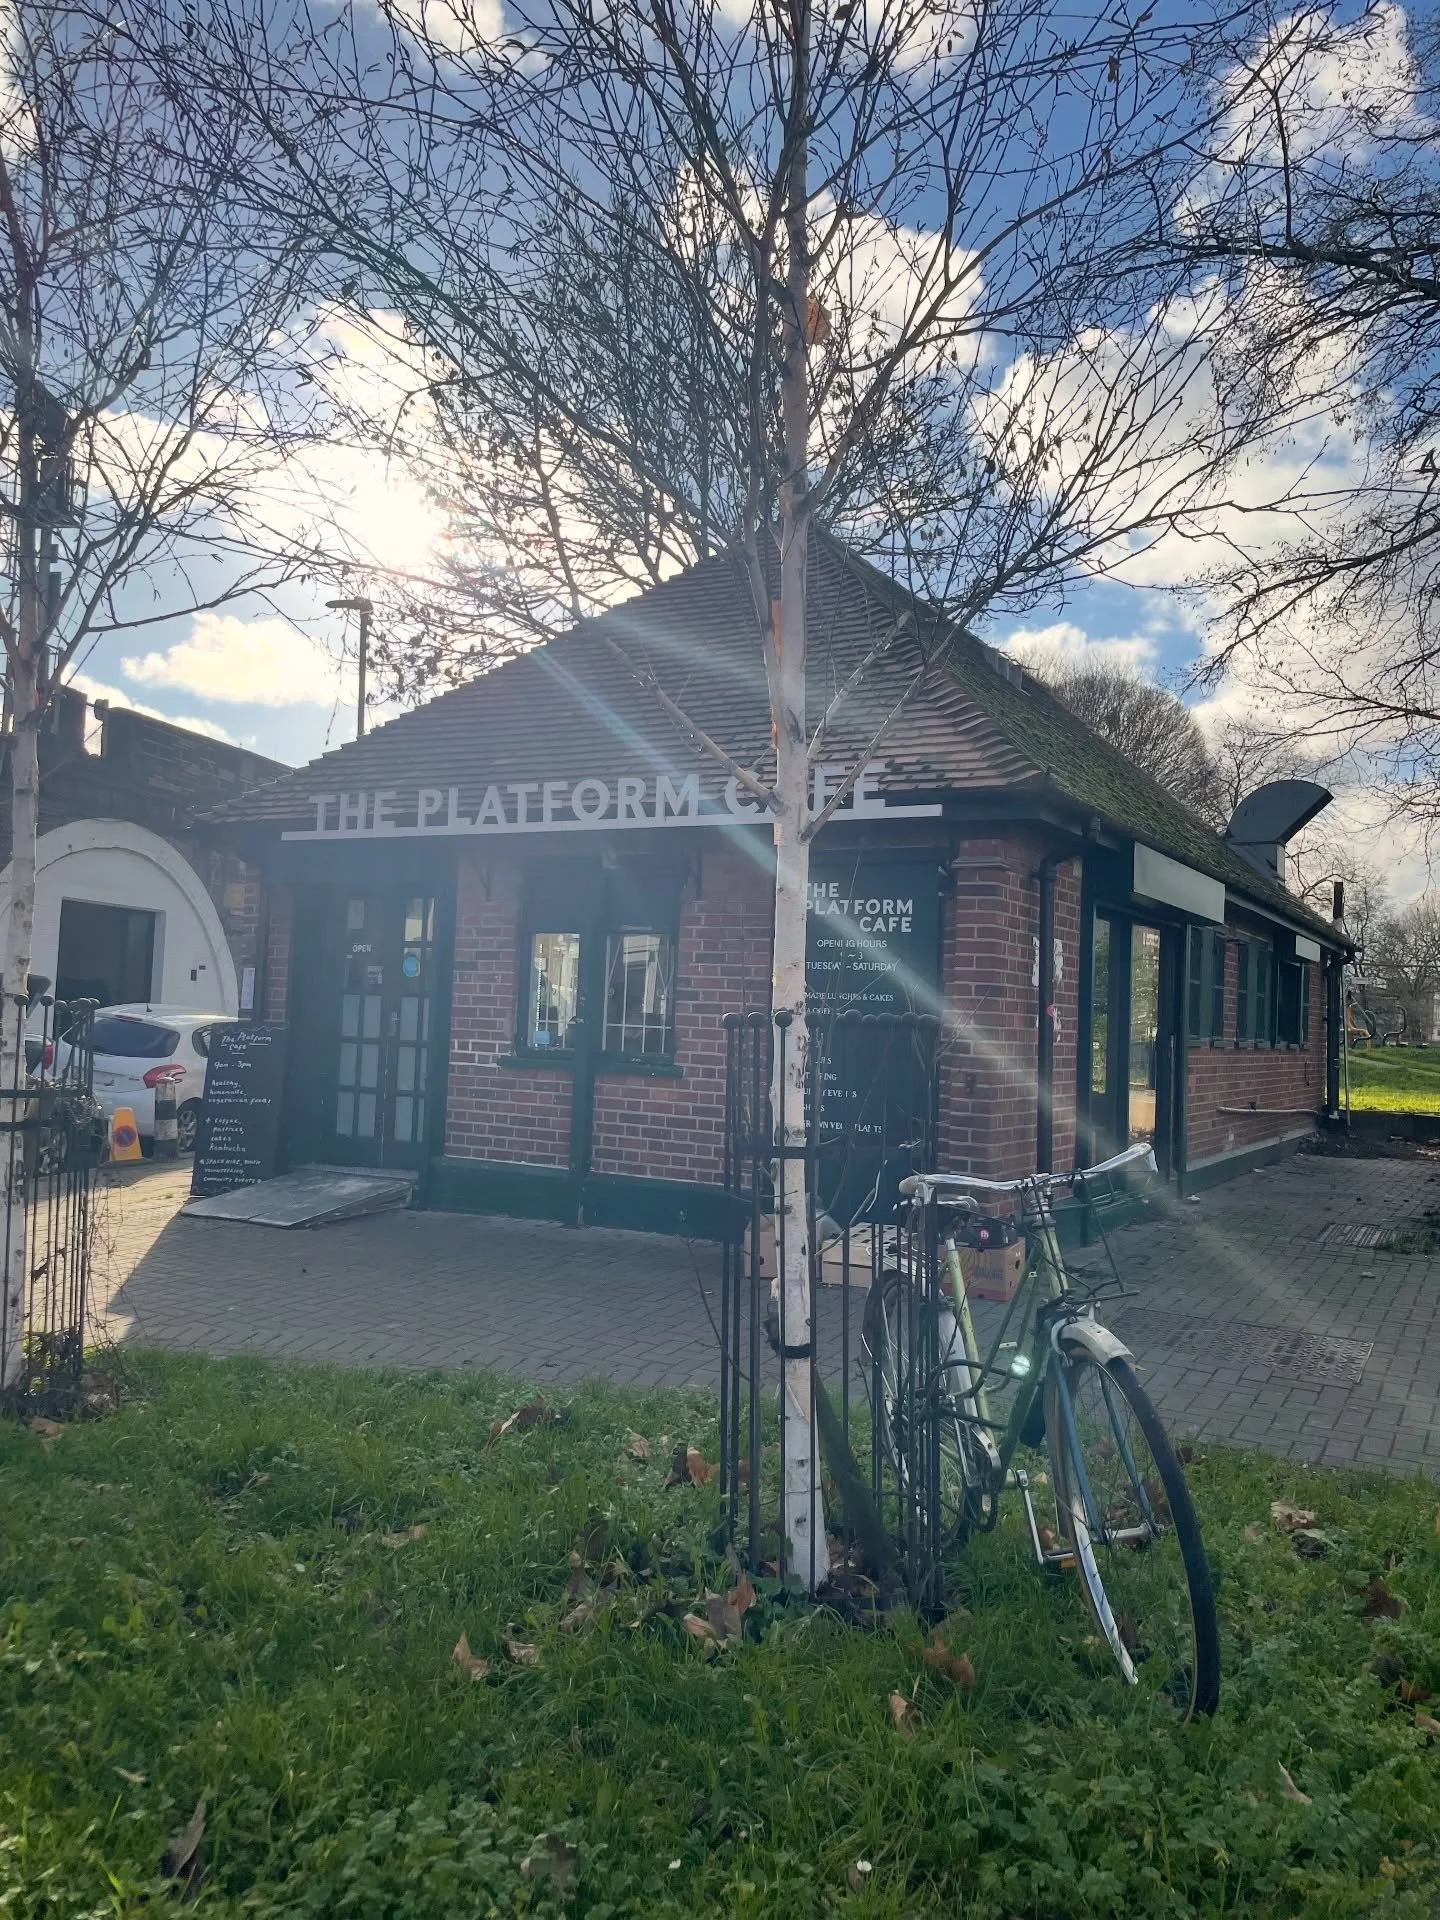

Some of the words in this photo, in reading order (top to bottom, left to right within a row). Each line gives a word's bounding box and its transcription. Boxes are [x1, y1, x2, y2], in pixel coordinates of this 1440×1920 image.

[308, 790, 397, 832] THE
[416, 773, 699, 830] PLATFORM
[724, 762, 887, 817] CFE
[806, 899, 913, 915] PLATFORM
[860, 917, 912, 933] CAFE
[352, 944, 372, 952] OPEN
[857, 940, 887, 948] HOURS
[858, 952, 864, 960] 3
[853, 962, 898, 972] SATURDAY
[828, 992, 861, 1001] LUCHES
[869, 994, 895, 1002] CAKES
[221, 1035, 234, 1044] The
[235, 1031, 272, 1043] Platform
[214, 1061, 229, 1070] 9am
[237, 1060, 252, 1069] 3pm
